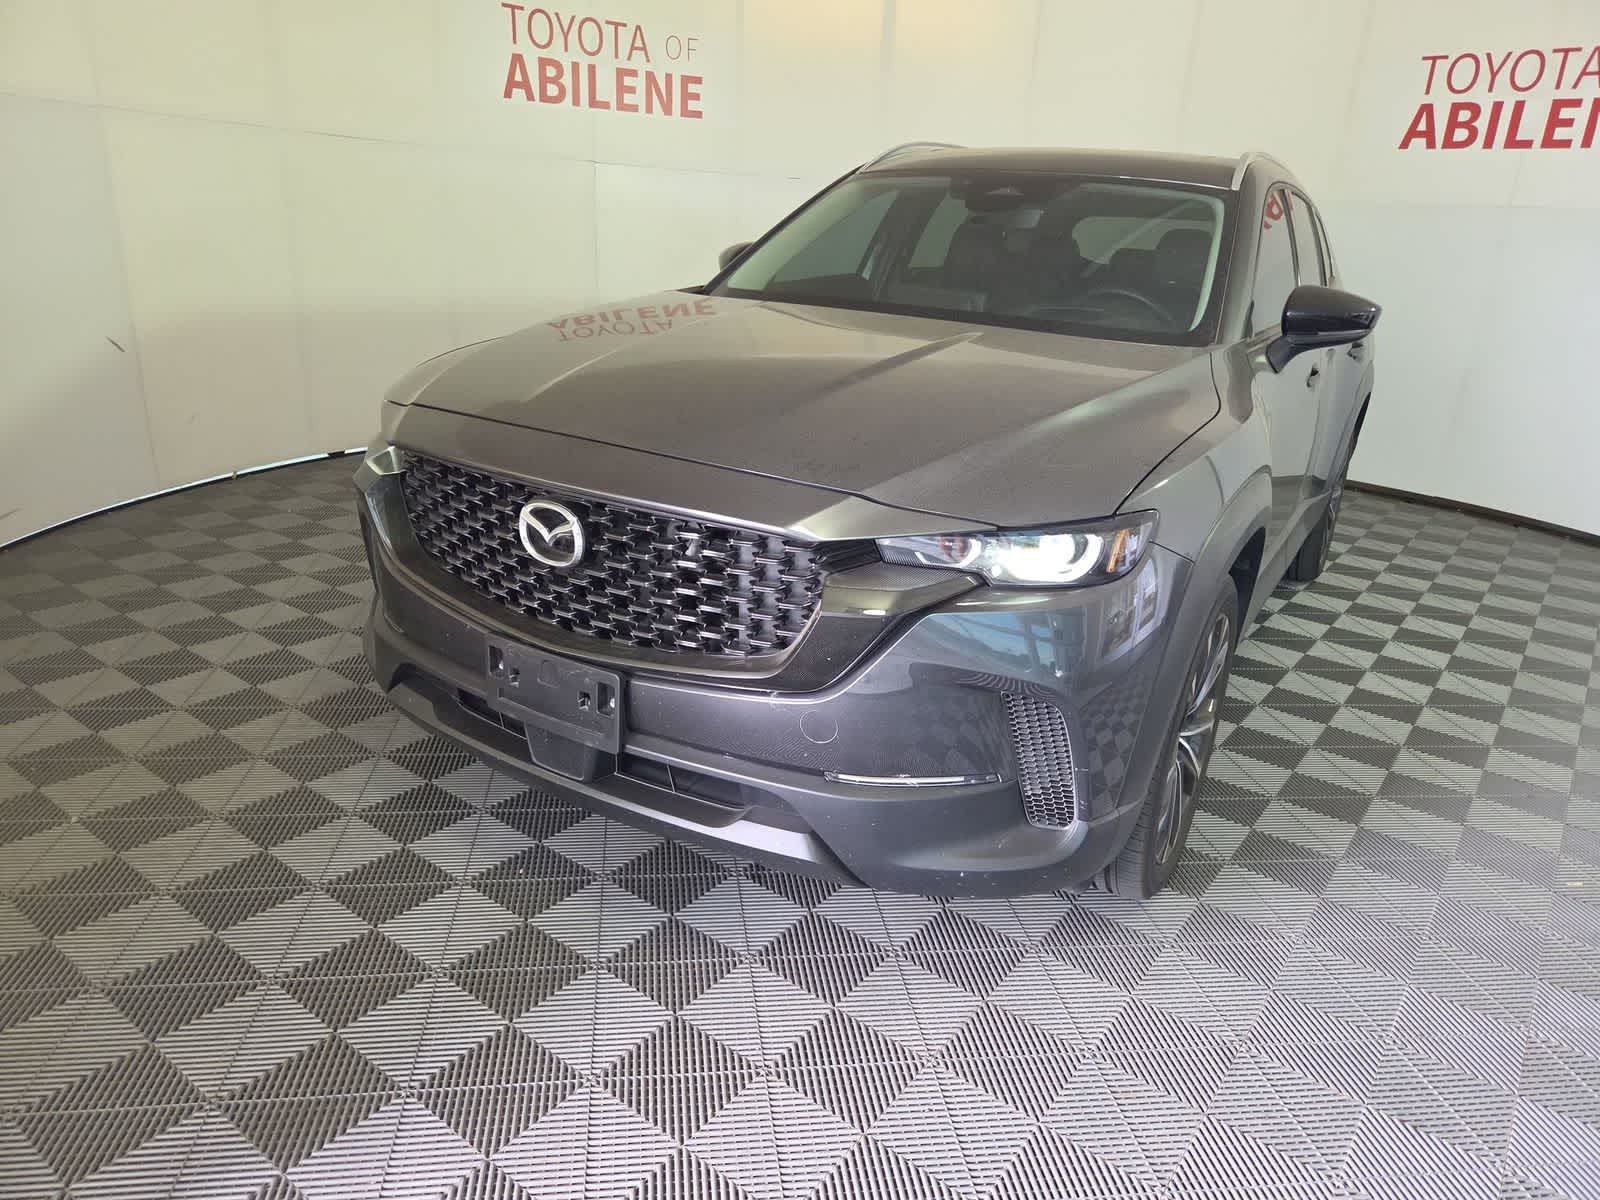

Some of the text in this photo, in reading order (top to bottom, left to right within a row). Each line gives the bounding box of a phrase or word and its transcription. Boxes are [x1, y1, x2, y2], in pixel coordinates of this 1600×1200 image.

[501, 2, 699, 63] TOYOTA OF
[503, 53, 704, 119] ABILENE
[1421, 45, 1600, 95] TOYOTA
